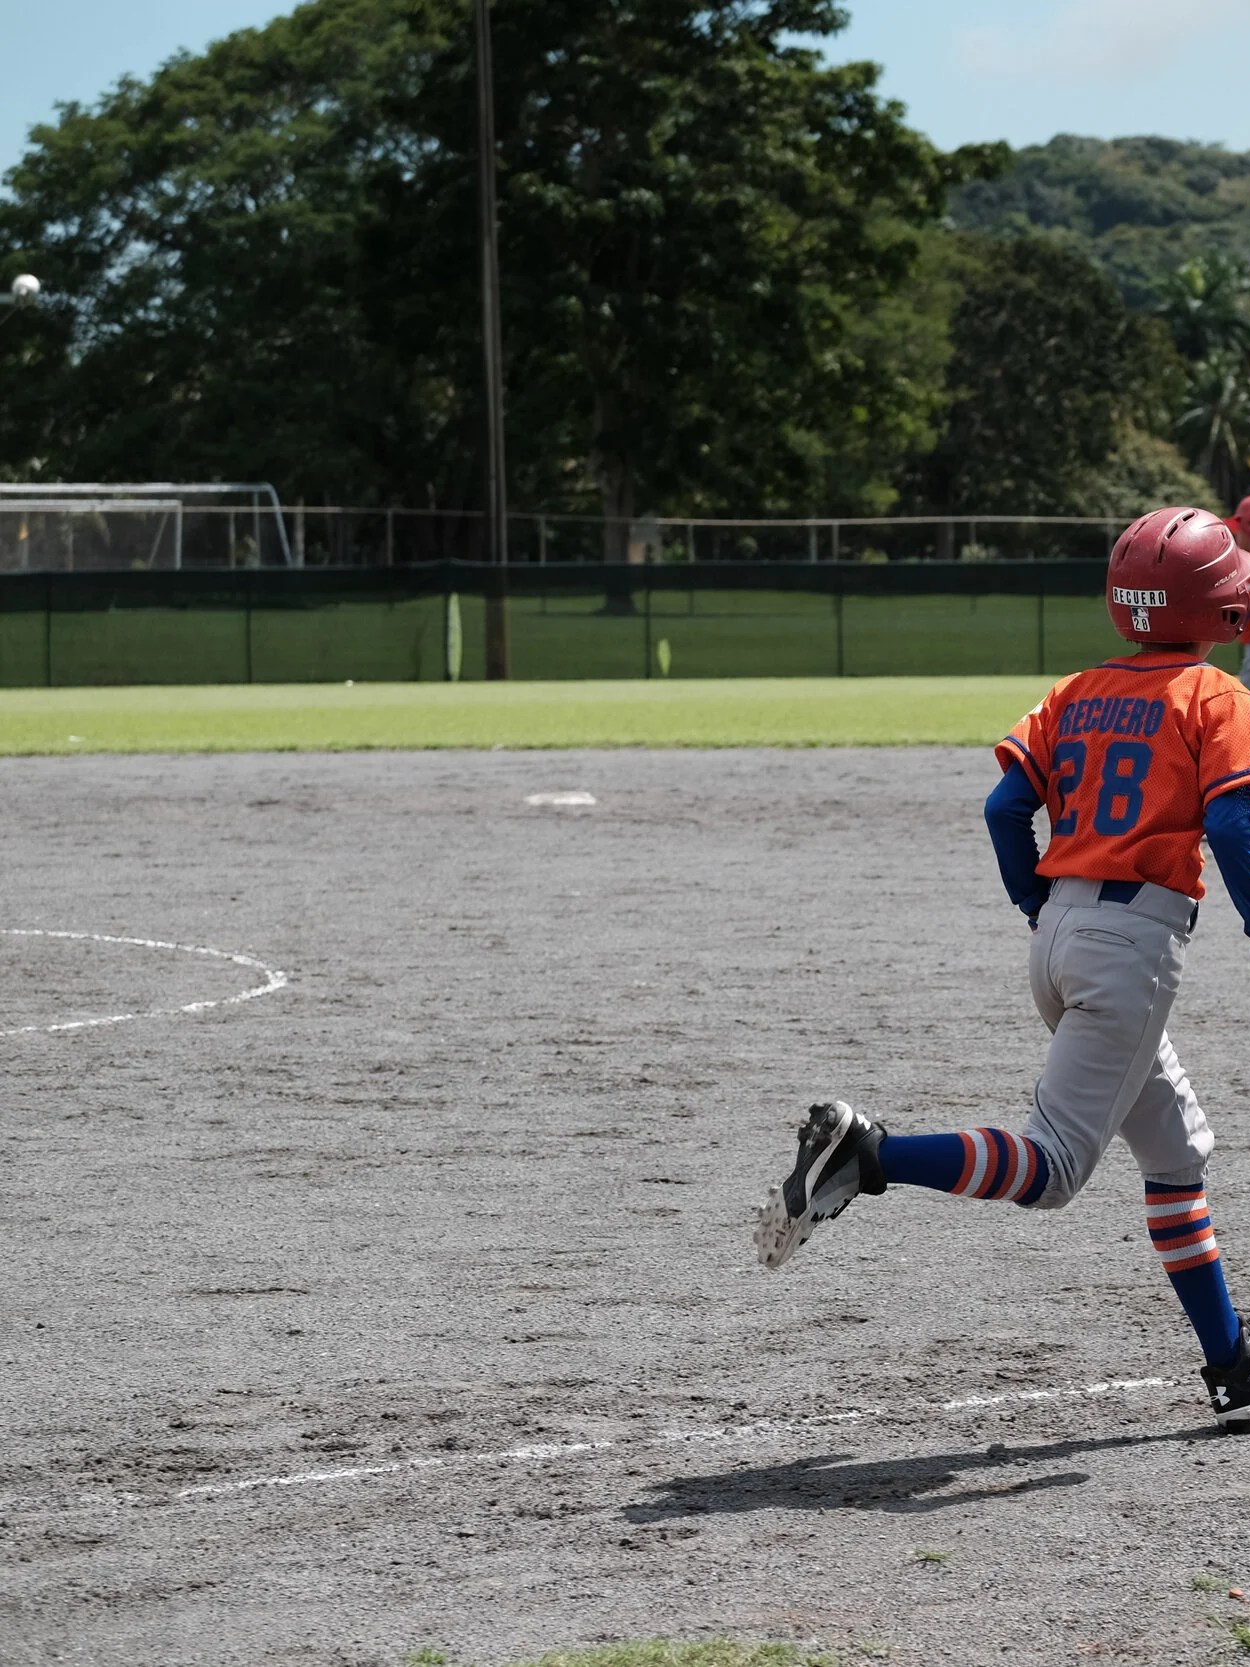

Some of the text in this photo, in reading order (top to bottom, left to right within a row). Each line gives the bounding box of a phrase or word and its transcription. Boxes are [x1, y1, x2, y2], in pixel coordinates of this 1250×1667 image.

[1114, 588, 1165, 605] RECUERO
[1133, 617, 1149, 631] 28
[1058, 697, 1165, 737] RECUERO
[1050, 740, 1153, 836] 28
